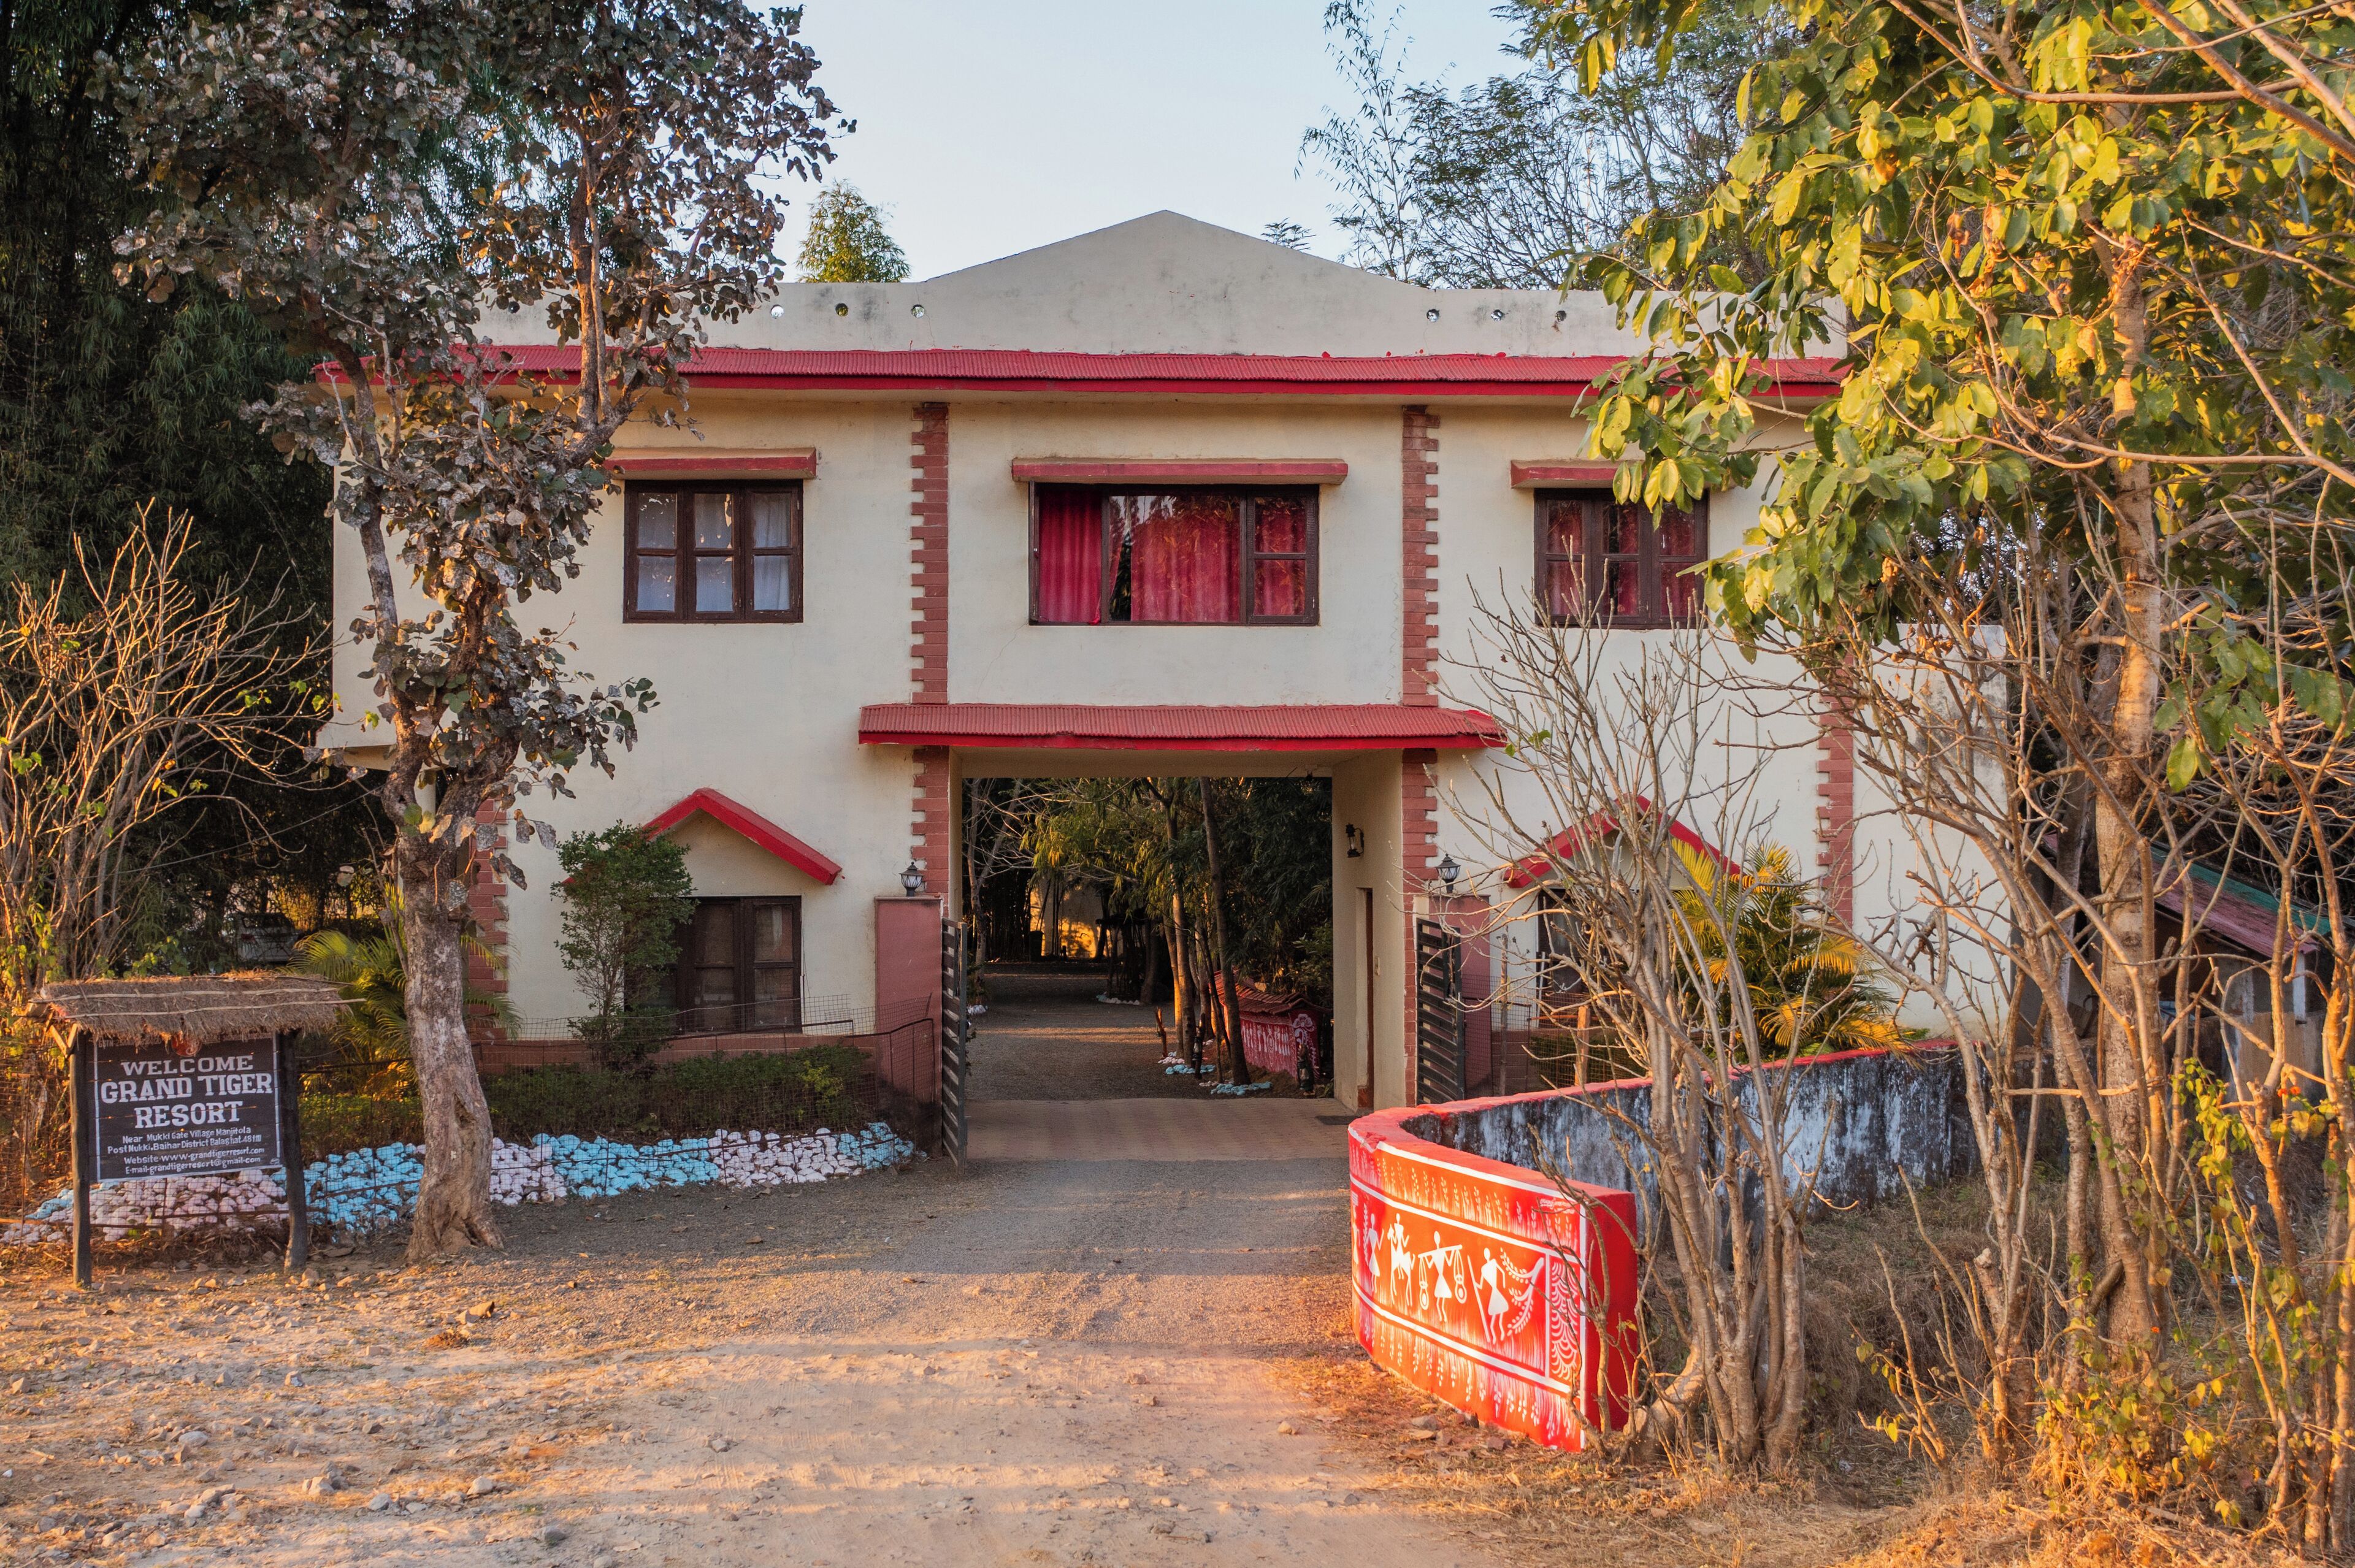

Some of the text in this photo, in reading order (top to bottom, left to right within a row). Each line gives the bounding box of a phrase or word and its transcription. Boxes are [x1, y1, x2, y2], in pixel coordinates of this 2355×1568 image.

[121, 1055, 253, 1076] WELCOME
[101, 1073, 273, 1104] GRAND TIGER
[134, 1101, 243, 1129] RESORT
[190, 1129, 215, 1138] Village
[216, 1126, 251, 1137] Manjitola
[107, 1145, 127, 1154] Post
[182, 1139, 209, 1149] District
